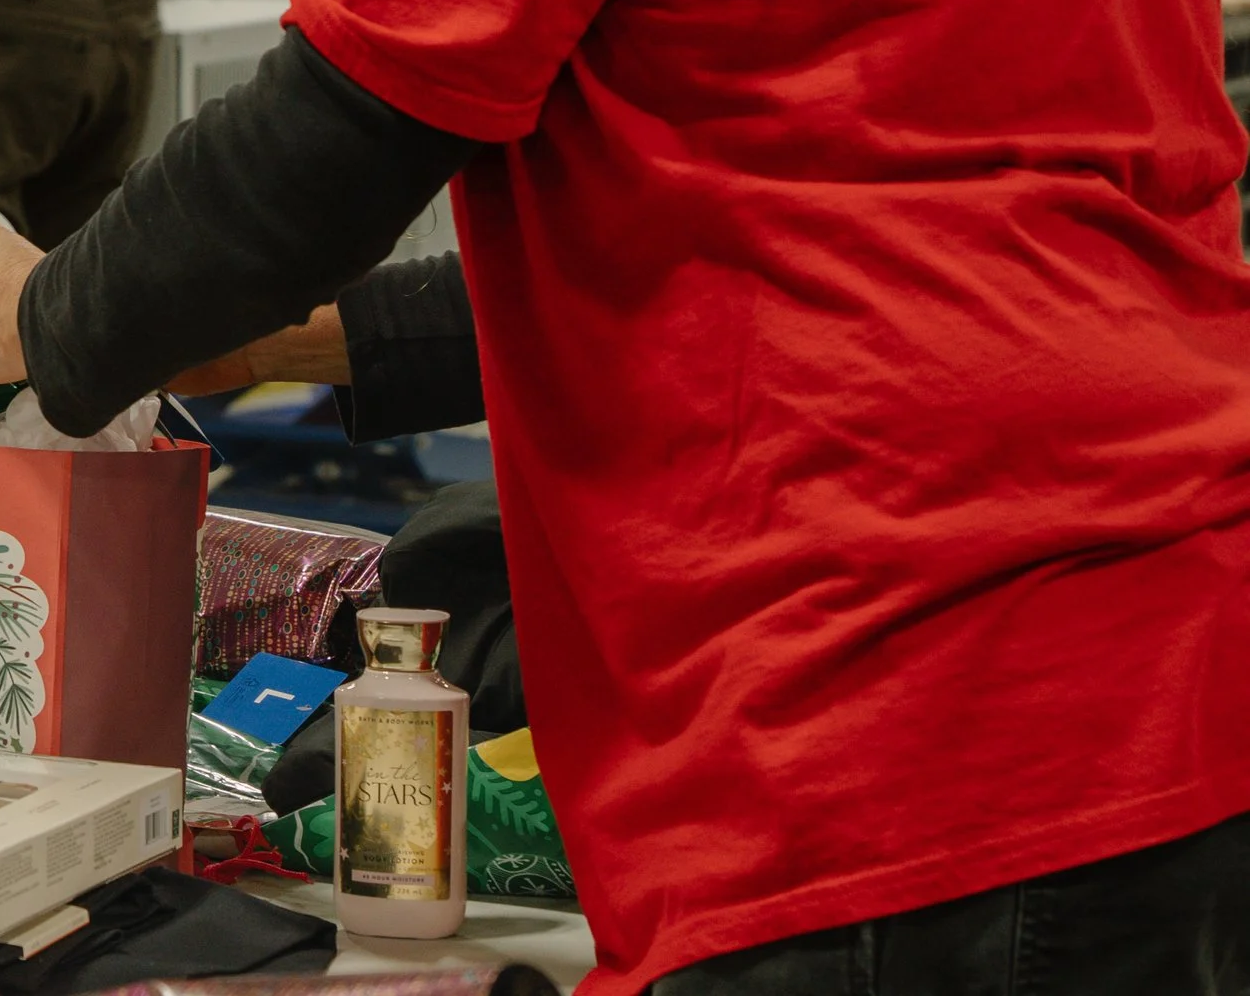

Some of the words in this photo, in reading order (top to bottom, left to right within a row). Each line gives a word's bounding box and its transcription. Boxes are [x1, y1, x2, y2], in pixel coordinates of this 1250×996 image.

[367, 767, 390, 780] in
[390, 764, 421, 780] the
[357, 781, 432, 806] STARS
